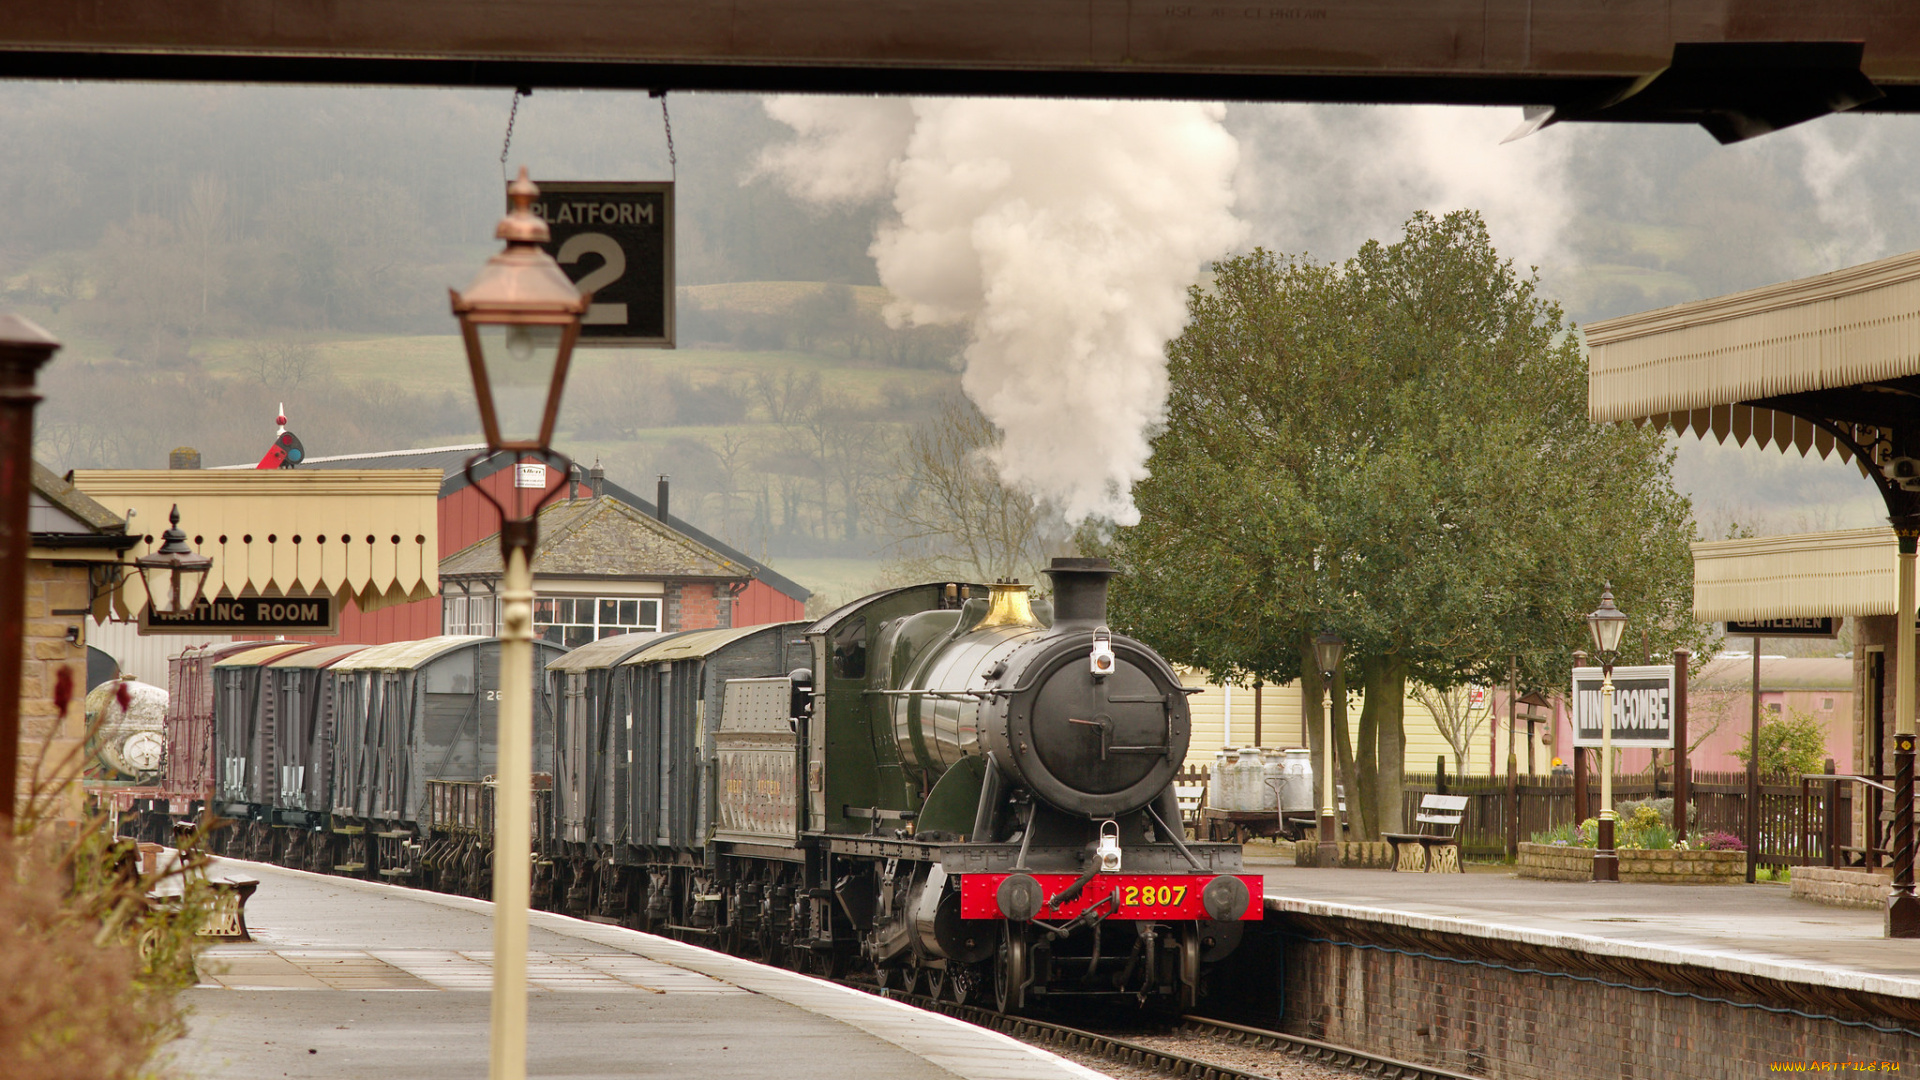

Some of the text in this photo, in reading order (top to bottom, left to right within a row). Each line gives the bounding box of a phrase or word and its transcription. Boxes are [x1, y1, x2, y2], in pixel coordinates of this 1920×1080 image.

[530, 203, 653, 224] PLATFORM
[557, 232, 628, 325] 2
[257, 603, 318, 621] ROOM
[1737, 617, 1822, 629] GENTLEMEN
[1580, 688, 1669, 730] WINHCOMBE
[1125, 885, 1187, 906] 2807
